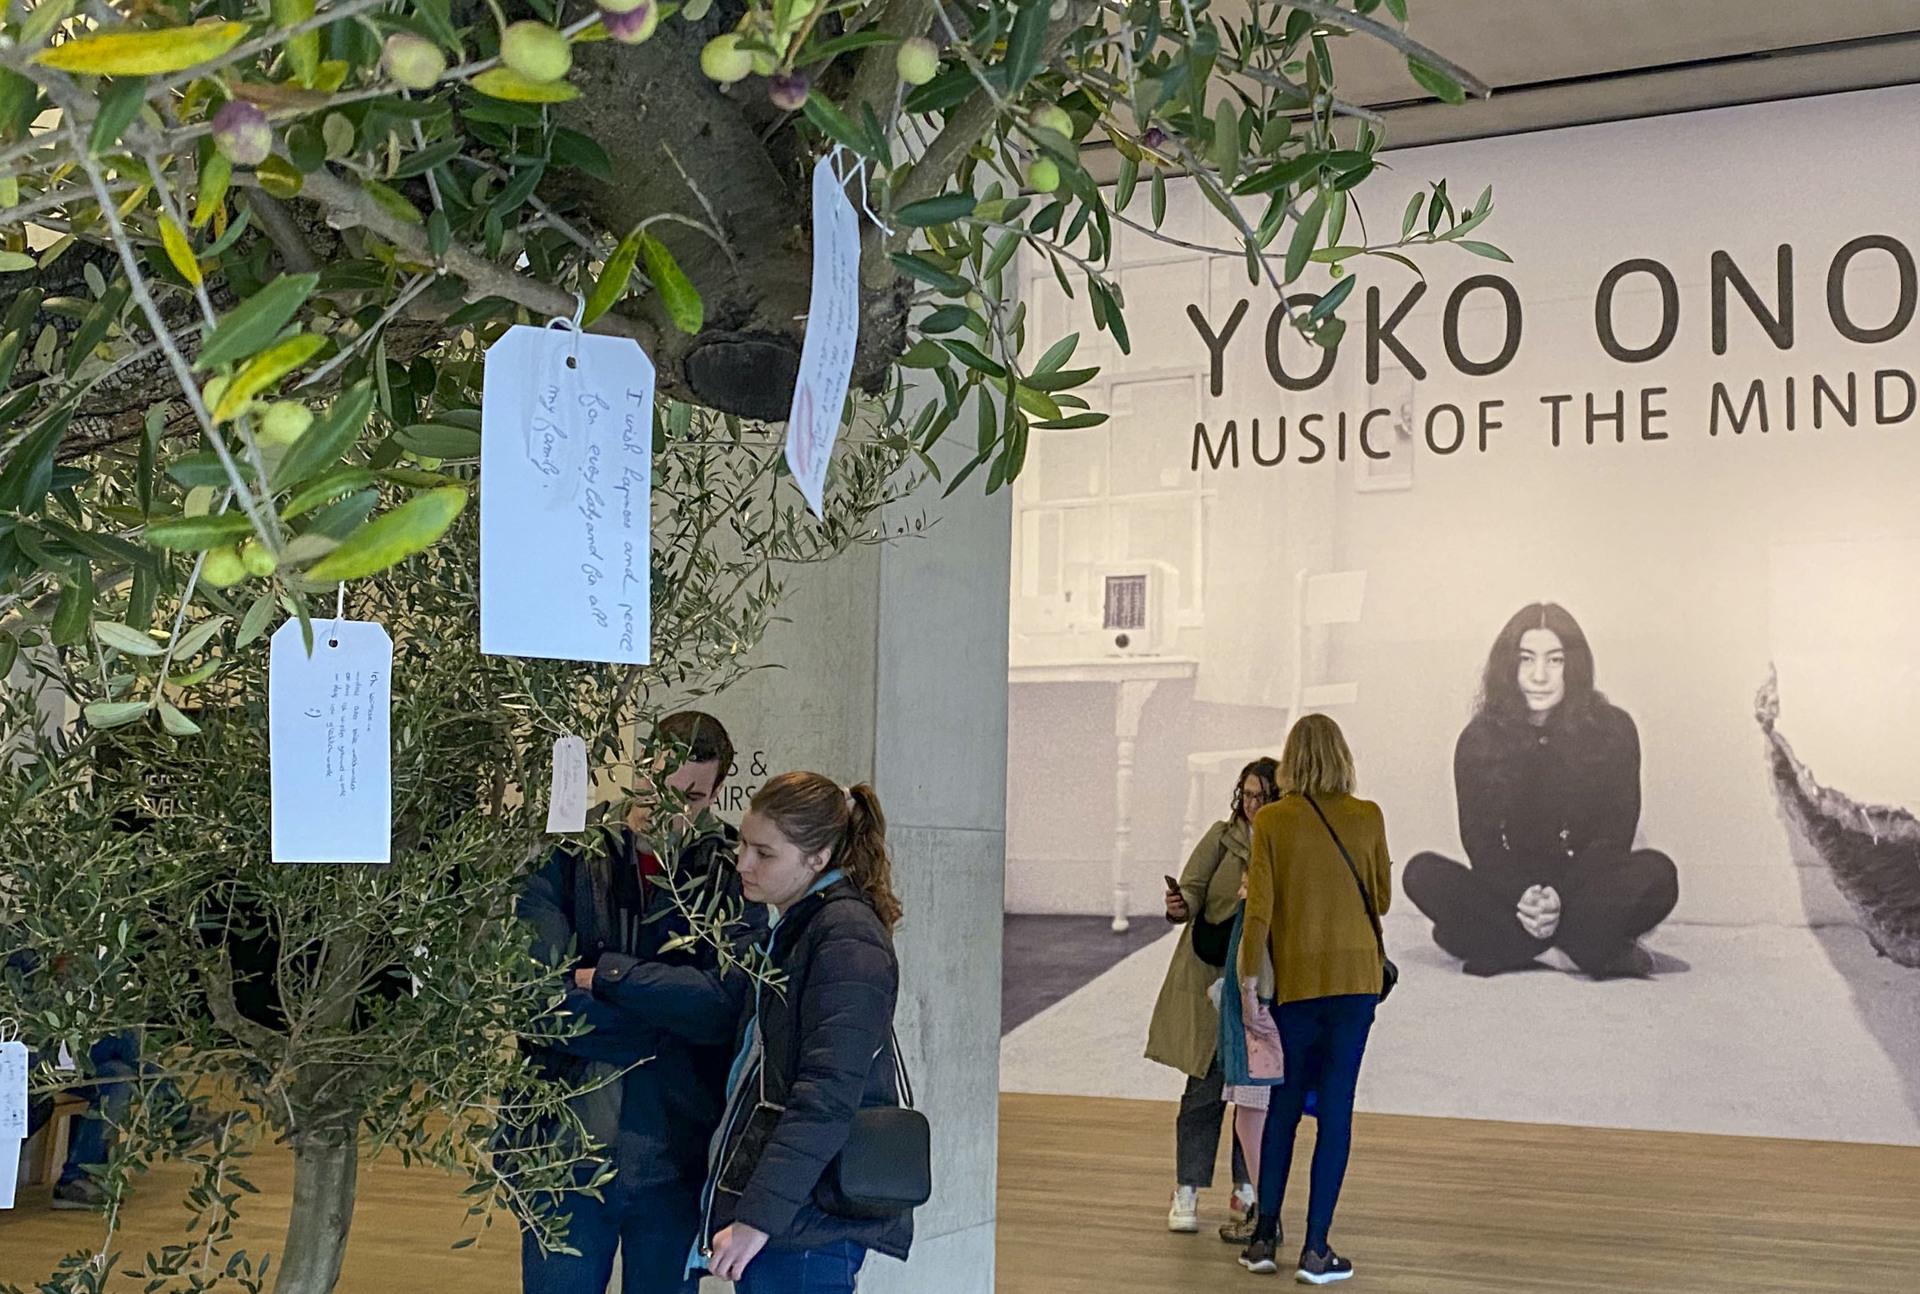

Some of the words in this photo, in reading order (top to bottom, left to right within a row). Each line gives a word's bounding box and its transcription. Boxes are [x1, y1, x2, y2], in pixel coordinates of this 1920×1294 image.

[1186, 274, 1522, 397] YOKO
[1595, 234, 1918, 364] ONO
[539, 385, 561, 414] my
[578, 394, 610, 425] for
[626, 387, 644, 408] I
[623, 414, 644, 455] wish
[1191, 408, 1391, 471] MUSIC
[1425, 400, 1504, 455] OF
[1540, 387, 1669, 447] THE
[1710, 369, 1917, 436] MIND
[622, 541, 639, 593] and
[618, 603, 634, 652] peace
[750, 750, 768, 777] &
